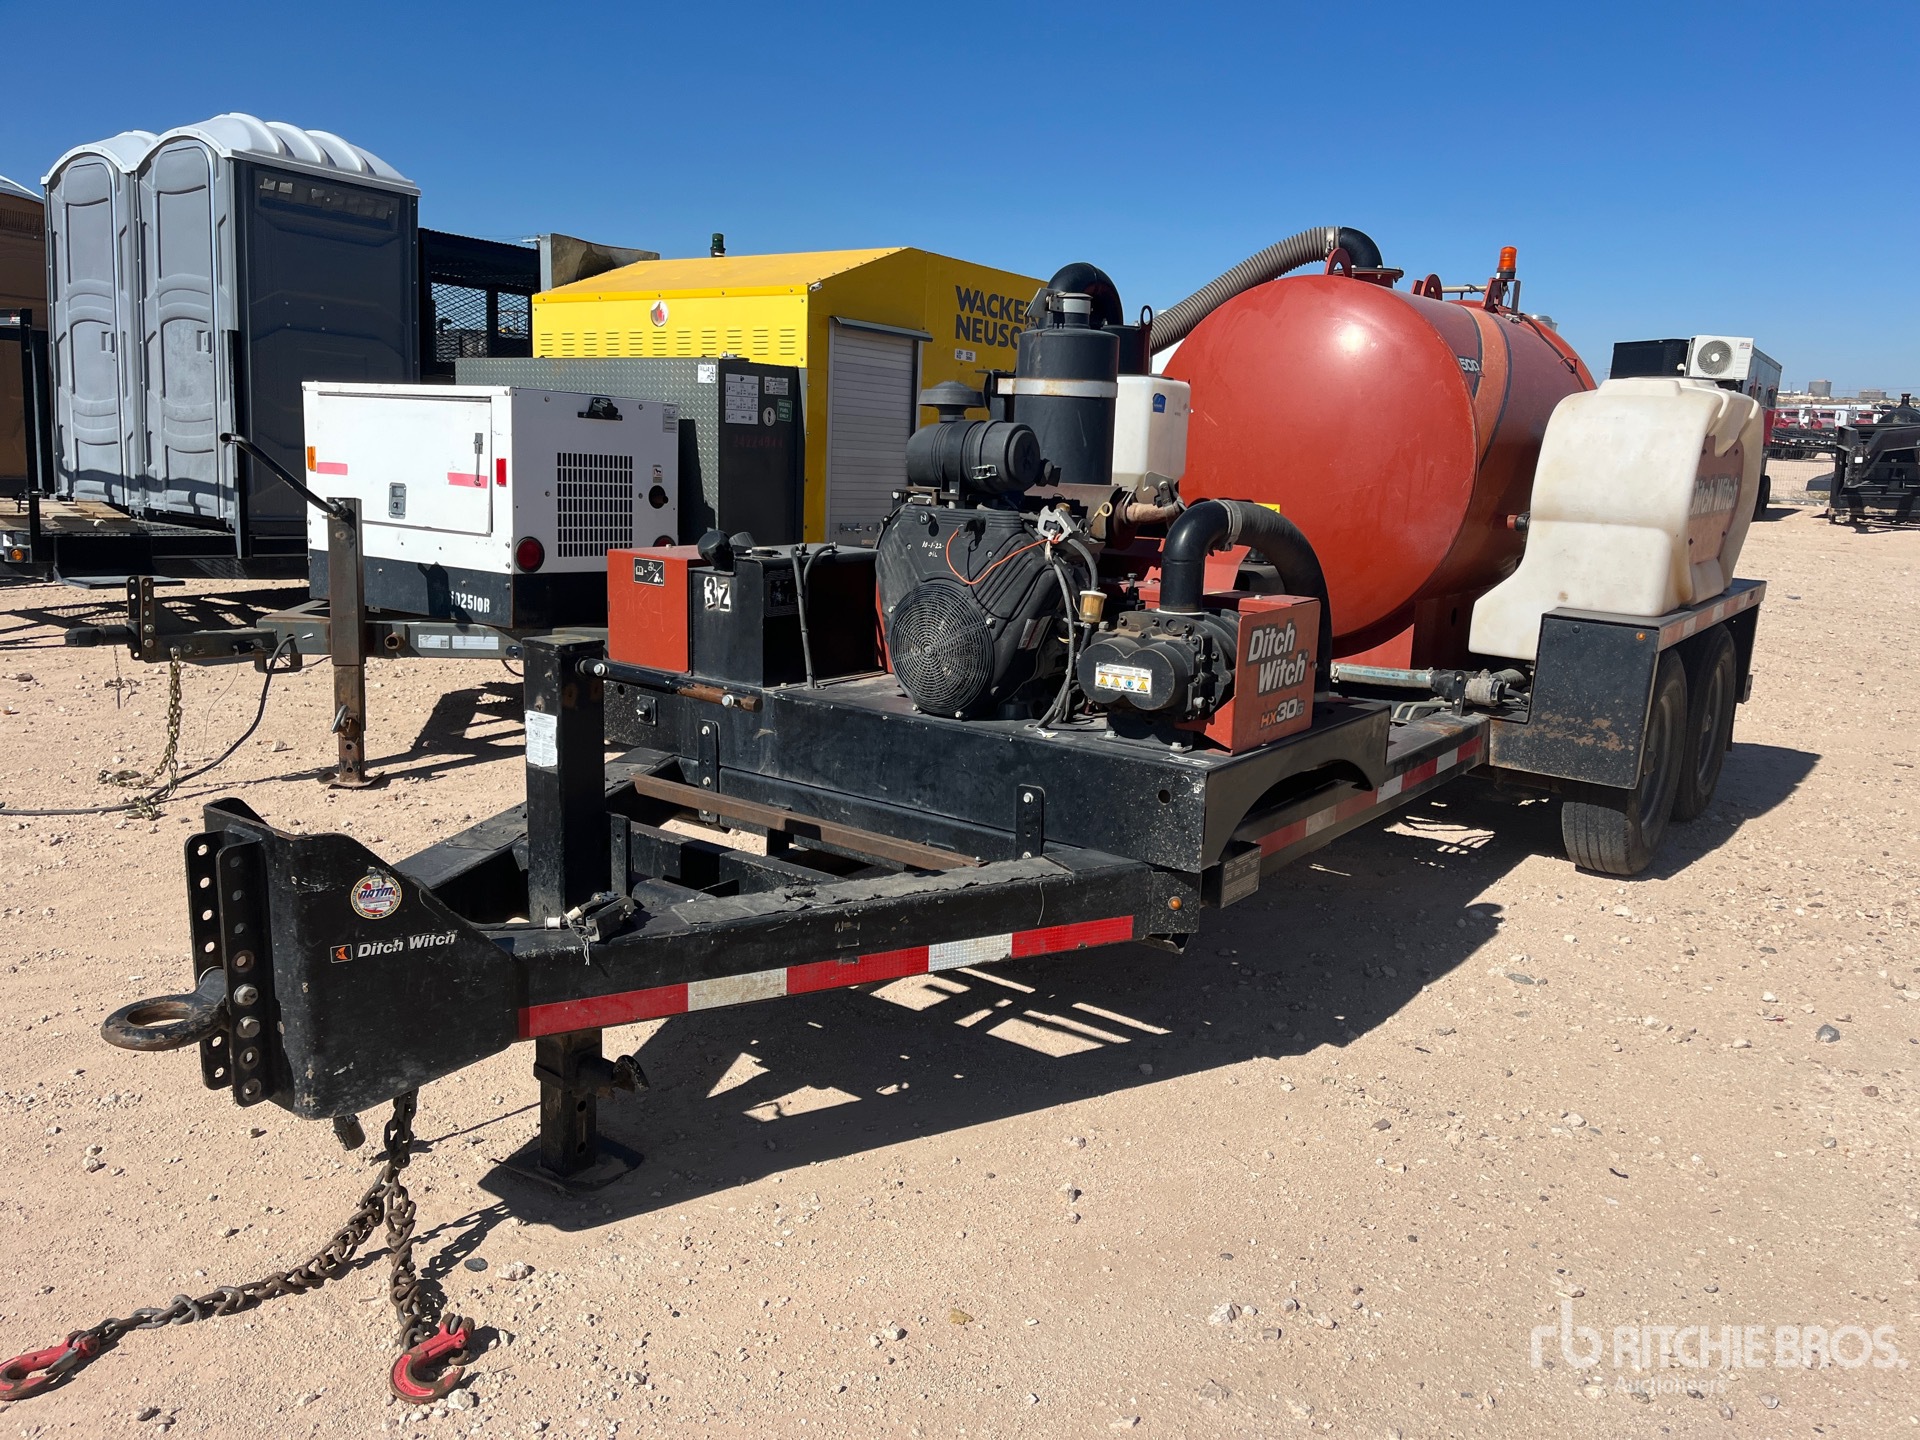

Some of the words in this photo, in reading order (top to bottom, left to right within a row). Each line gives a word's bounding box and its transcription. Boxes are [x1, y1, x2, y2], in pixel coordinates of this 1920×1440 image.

[1247, 622, 1296, 662] Ditch
[1258, 653, 1306, 694] Witch
[1260, 698, 1305, 729] HX30G
[357, 940, 404, 958] Ditch
[408, 931, 457, 950] Witch
